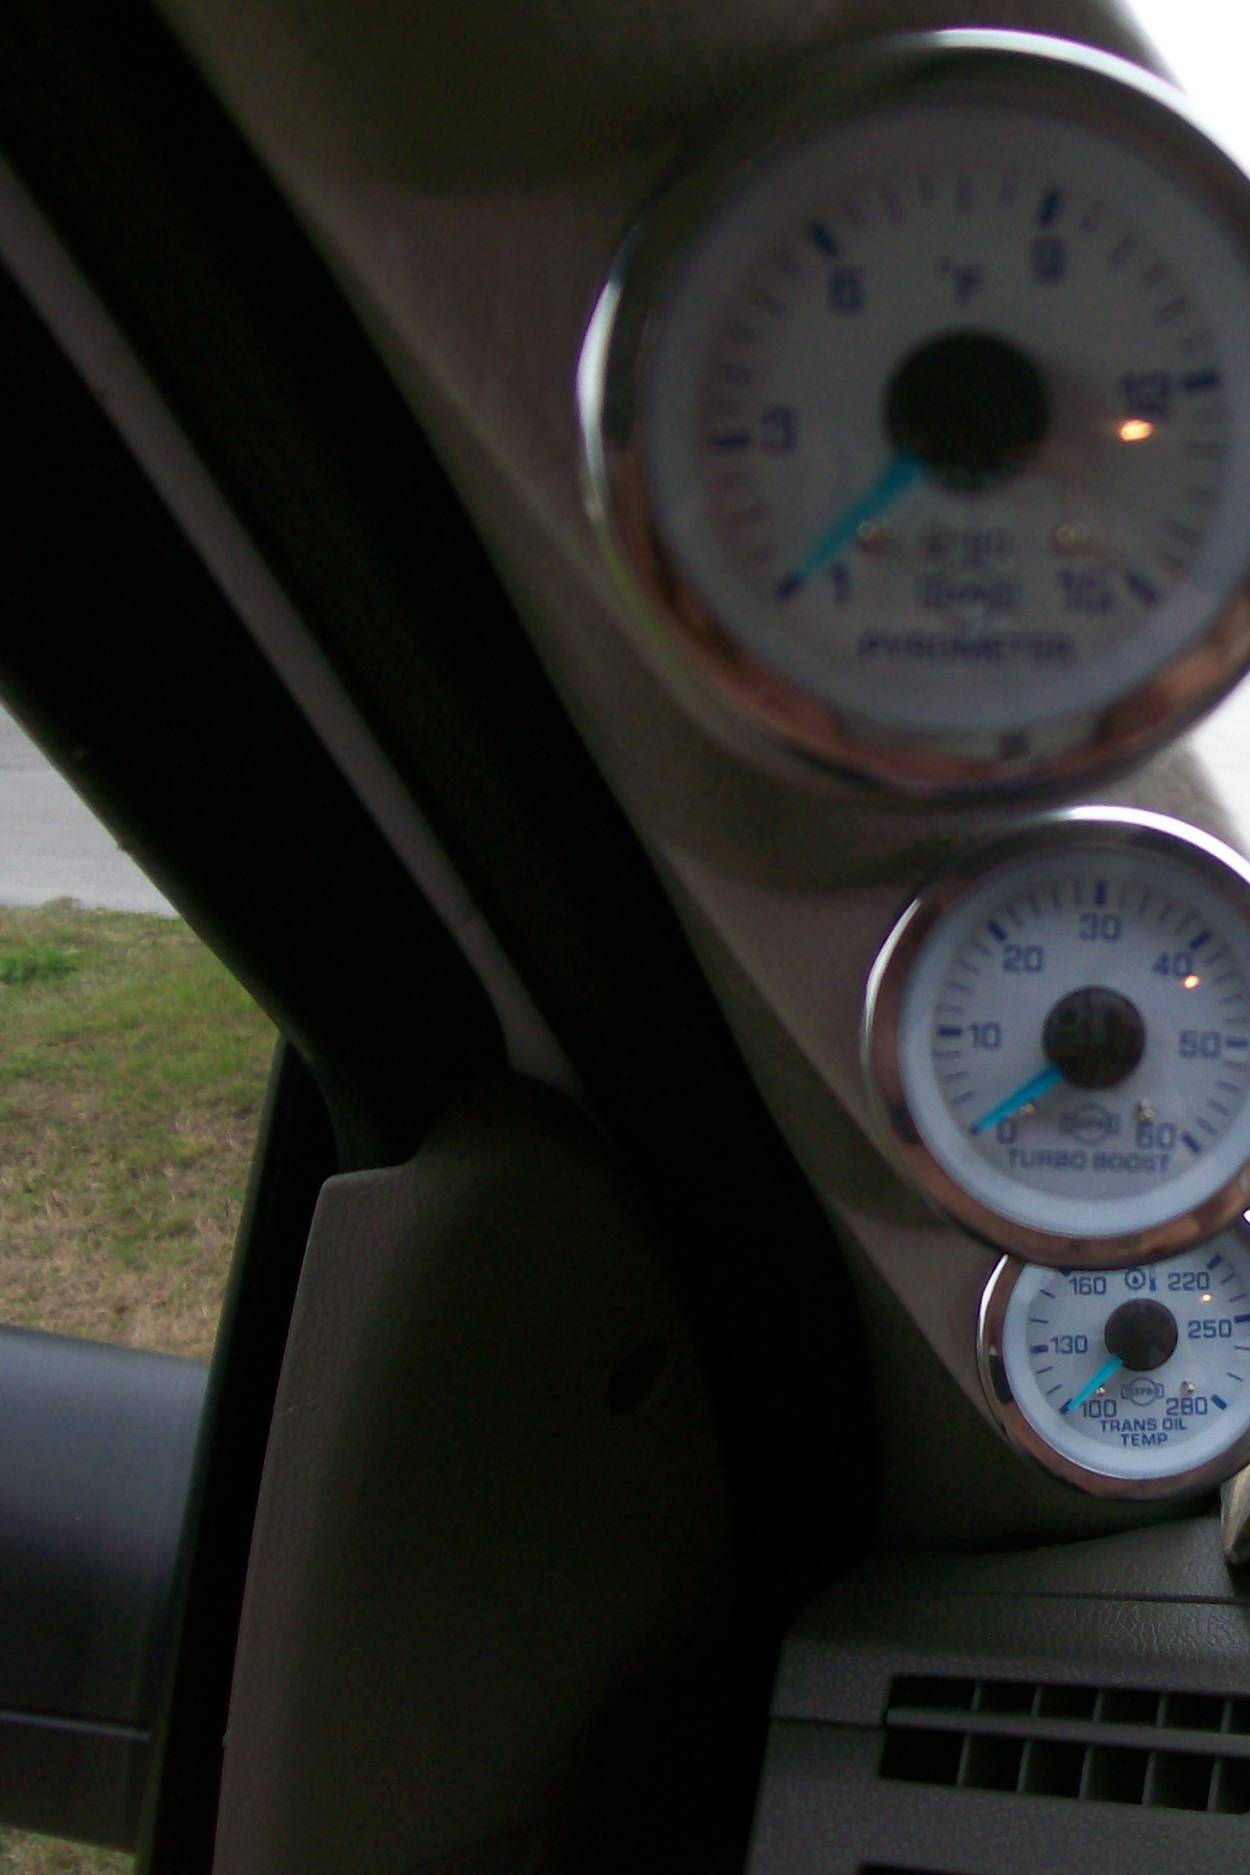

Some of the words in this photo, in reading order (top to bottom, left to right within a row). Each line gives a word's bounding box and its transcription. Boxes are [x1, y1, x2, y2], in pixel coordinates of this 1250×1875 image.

[762, 407, 797, 452] 3
[825, 563, 851, 604] 1
[1079, 914, 1120, 942] 30
[1003, 946, 1044, 973] 20
[1152, 951, 1193, 977] 40
[971, 1023, 1001, 1049] 10
[1179, 1030, 1221, 1058] 50
[996, 1122, 1016, 1144] 0
[1136, 1123, 1175, 1151] 60
[1006, 1149, 1085, 1168] TURBO
[1093, 1152, 1171, 1172] BOOST
[1069, 1276, 1106, 1295] 160
[1168, 1272, 1210, 1291] 220
[1188, 1319, 1231, 1338] 250
[1050, 1335, 1088, 1353] 130
[1082, 1400, 1116, 1418] 100
[1166, 1397, 1208, 1416] 280
[1100, 1420, 1157, 1432] TRANS
[1162, 1418, 1187, 1430] OIL
[1120, 1434, 1168, 1447] TEMP
